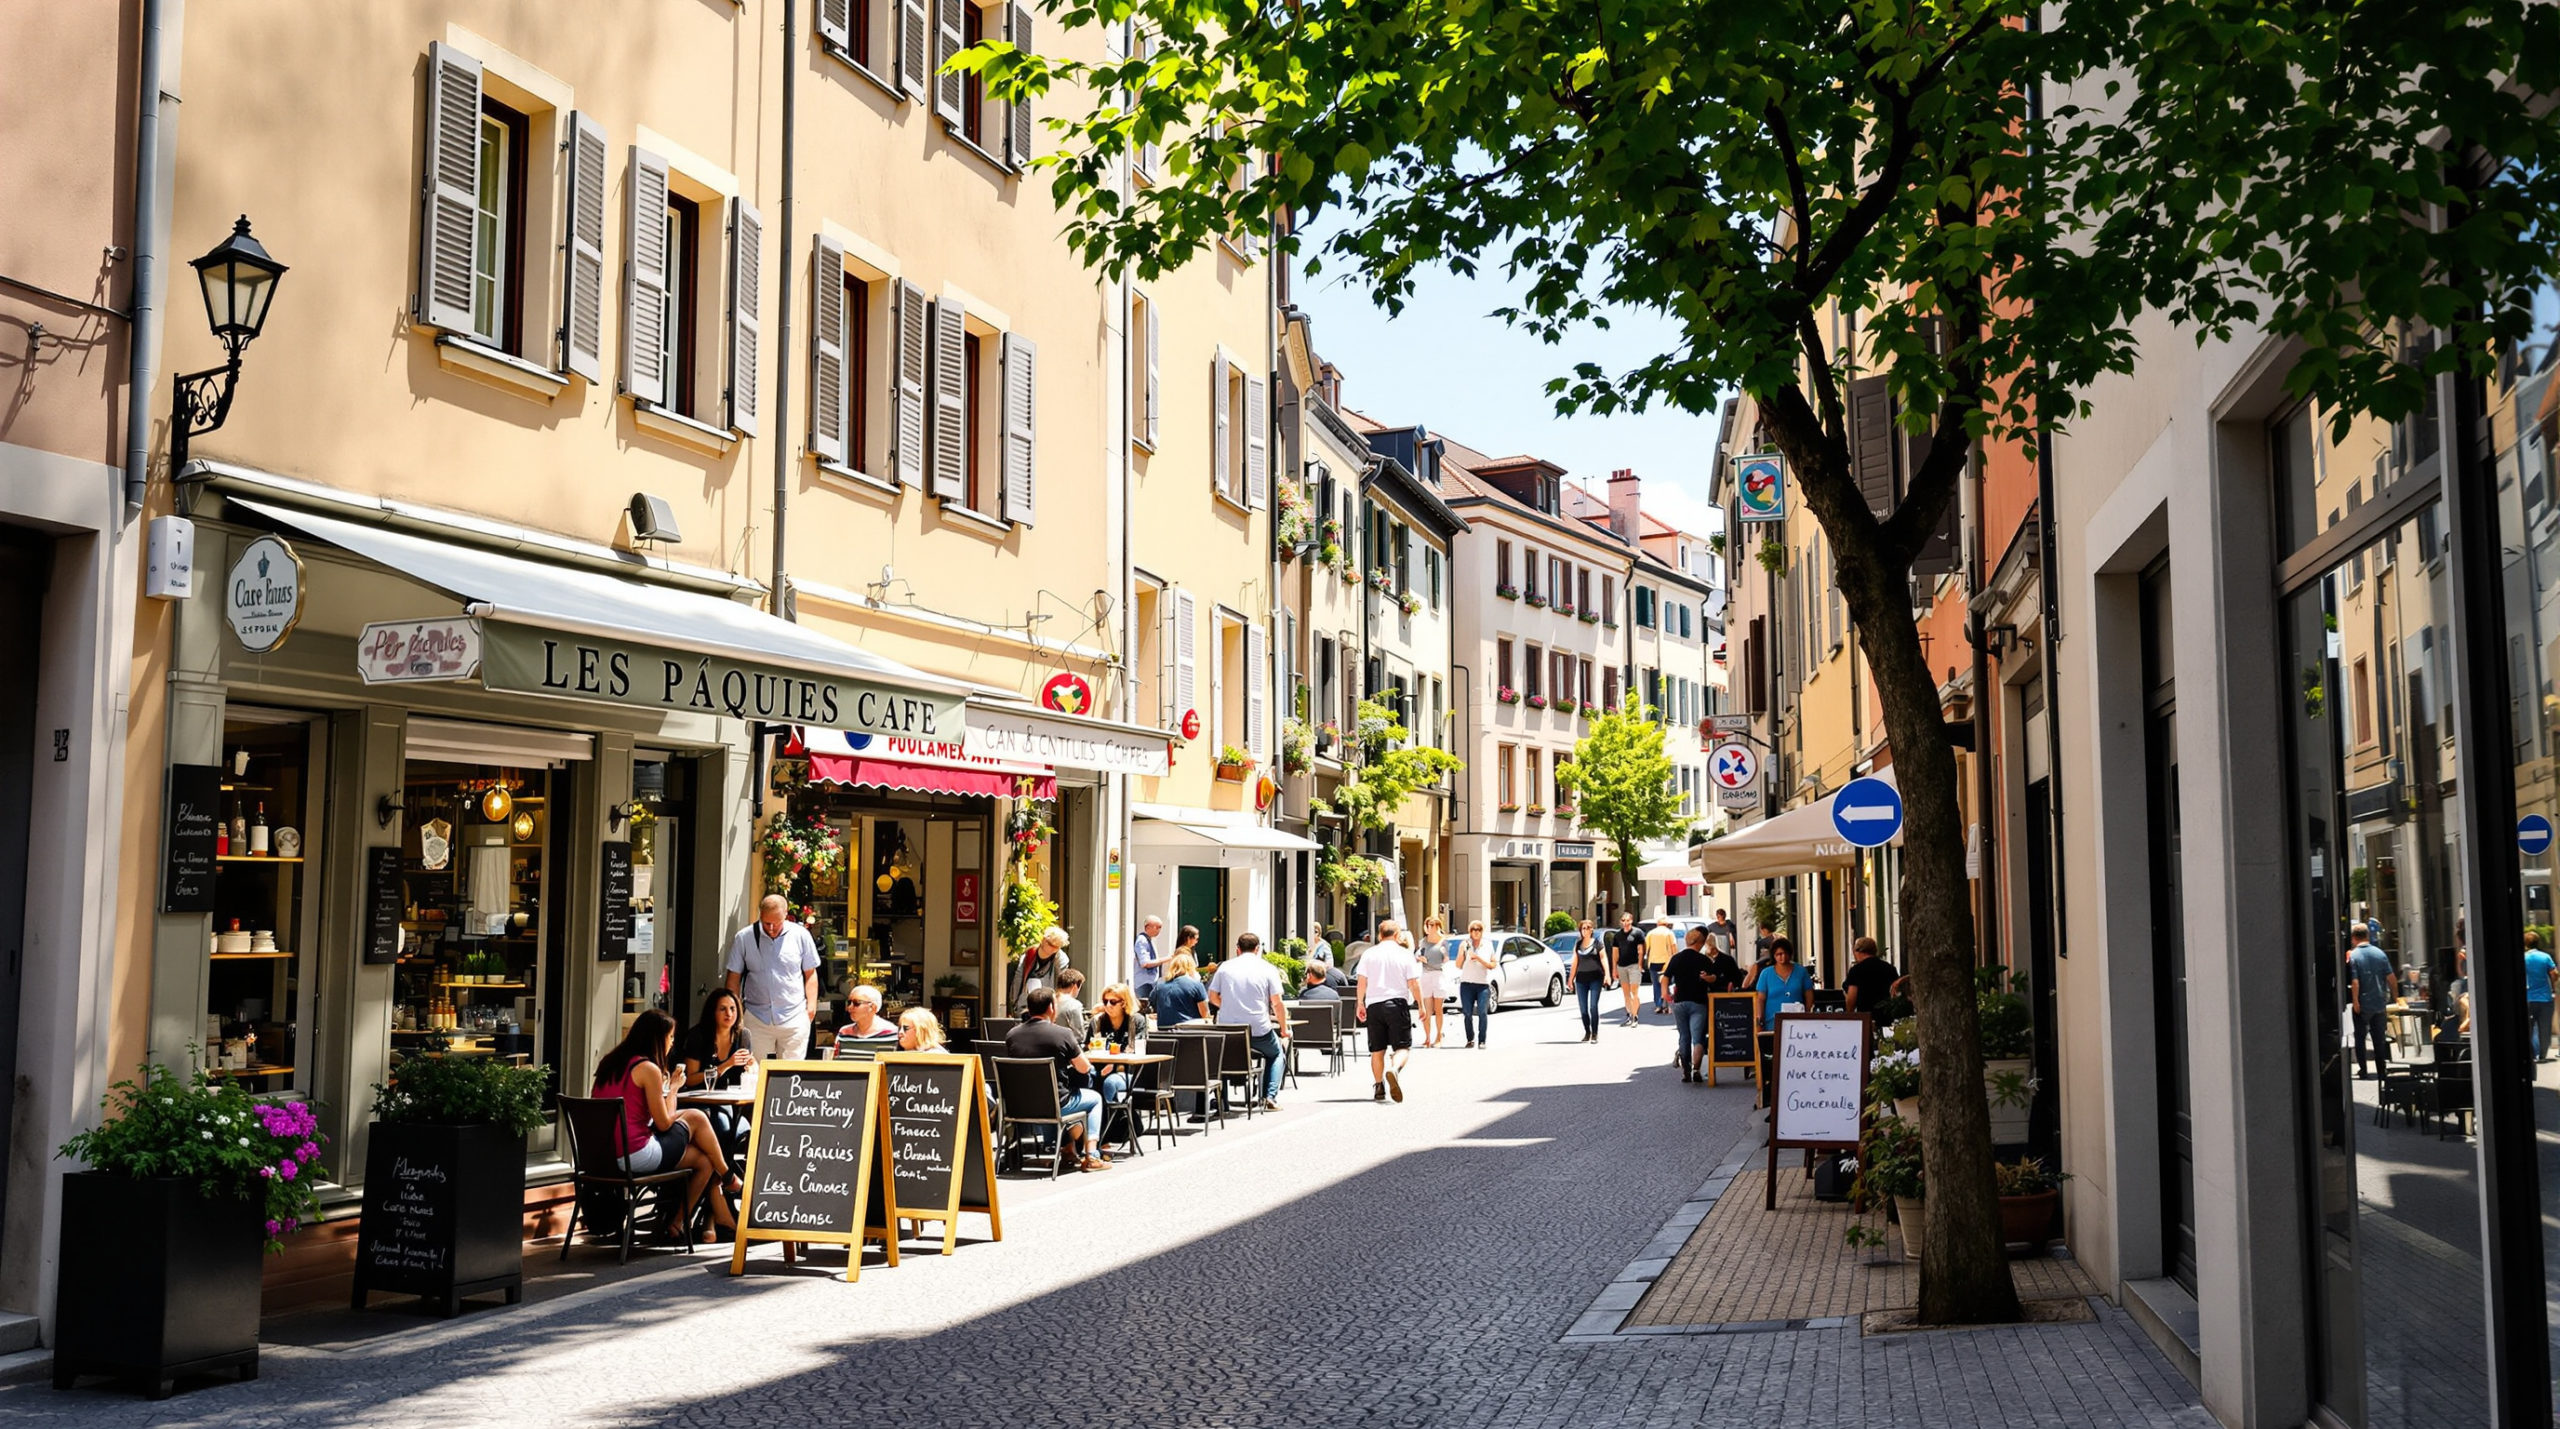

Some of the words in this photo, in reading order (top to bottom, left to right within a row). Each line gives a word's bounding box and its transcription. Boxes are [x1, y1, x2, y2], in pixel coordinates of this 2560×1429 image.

[541, 640, 630, 698] LES
[662, 657, 839, 725] PÁQUIES
[858, 693, 937, 735] CAFE
